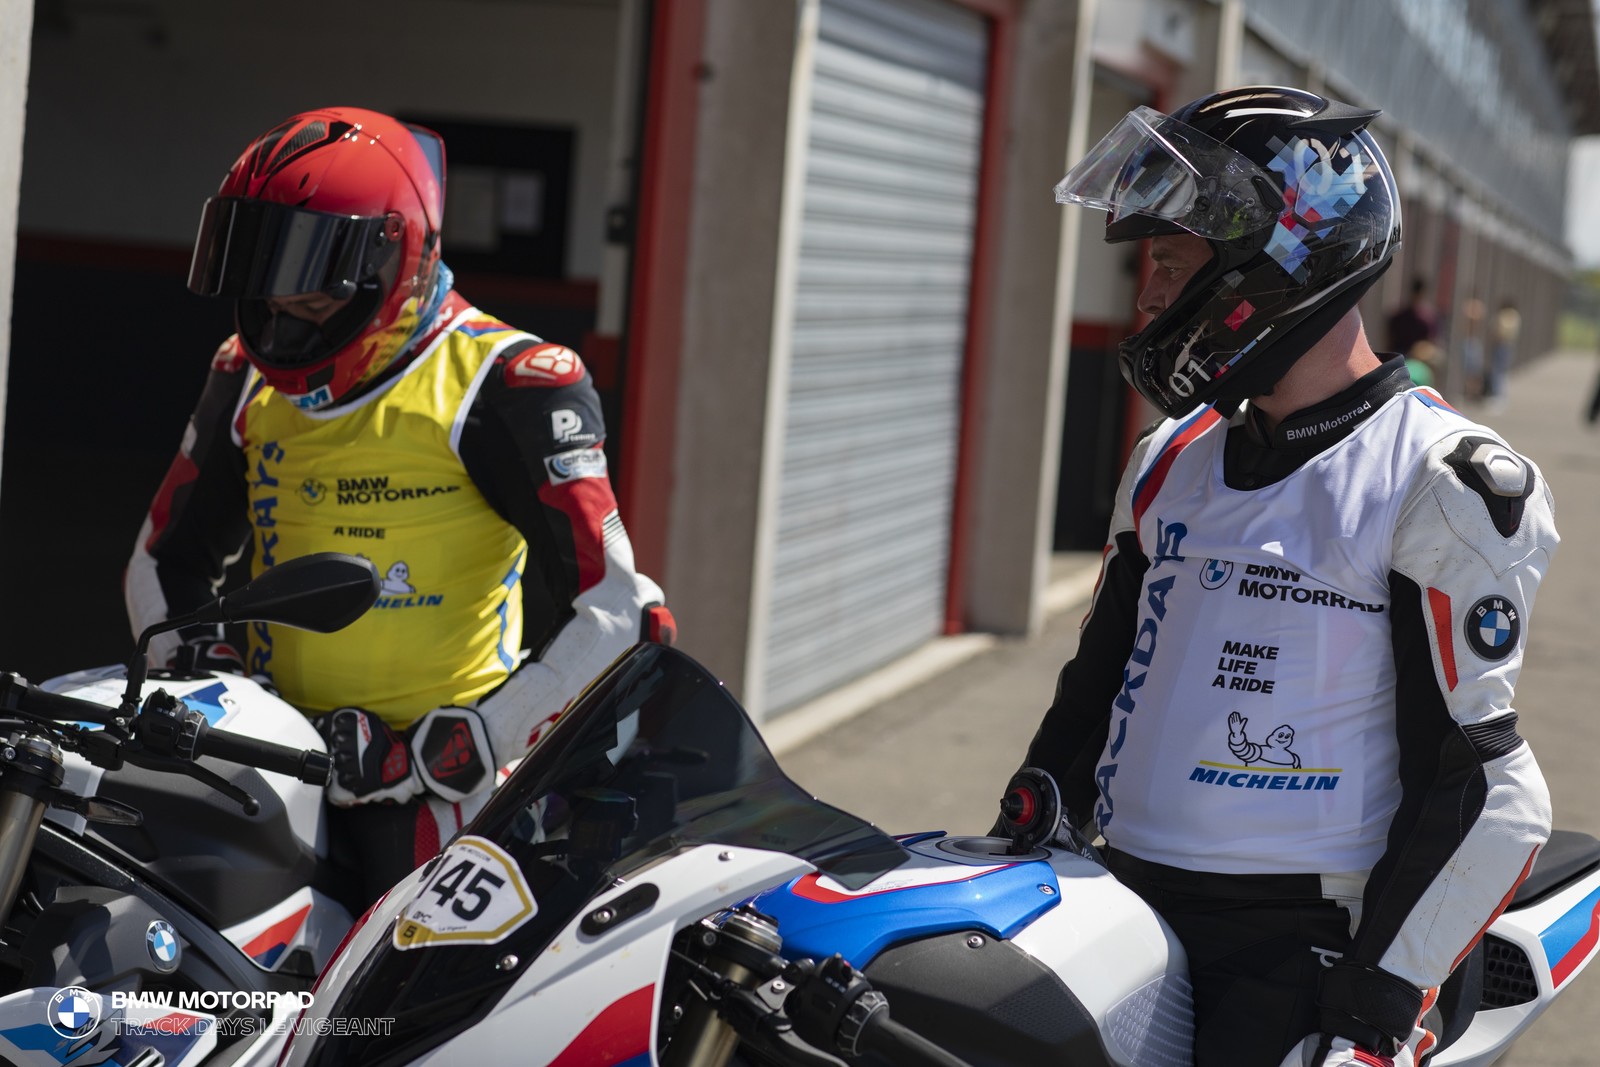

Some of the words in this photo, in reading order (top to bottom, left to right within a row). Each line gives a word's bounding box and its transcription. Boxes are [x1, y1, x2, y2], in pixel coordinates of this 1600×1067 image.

[1168, 359, 1212, 398] 01
[1286, 425, 1318, 441] BMW
[1319, 400, 1372, 433] Motorrad
[337, 476, 389, 492] BMW
[332, 526, 345, 537] A
[348, 526, 386, 539] RIDE
[1245, 563, 1302, 583] BMW
[373, 594, 444, 609] HELIN
[1476, 599, 1517, 622] BMW
[1222, 640, 1280, 660] MAKE
[1217, 656, 1259, 675] LIFE
[1211, 674, 1227, 689] A
[1229, 678, 1276, 695] RIDE
[1189, 766, 1340, 791] MICHELIN
